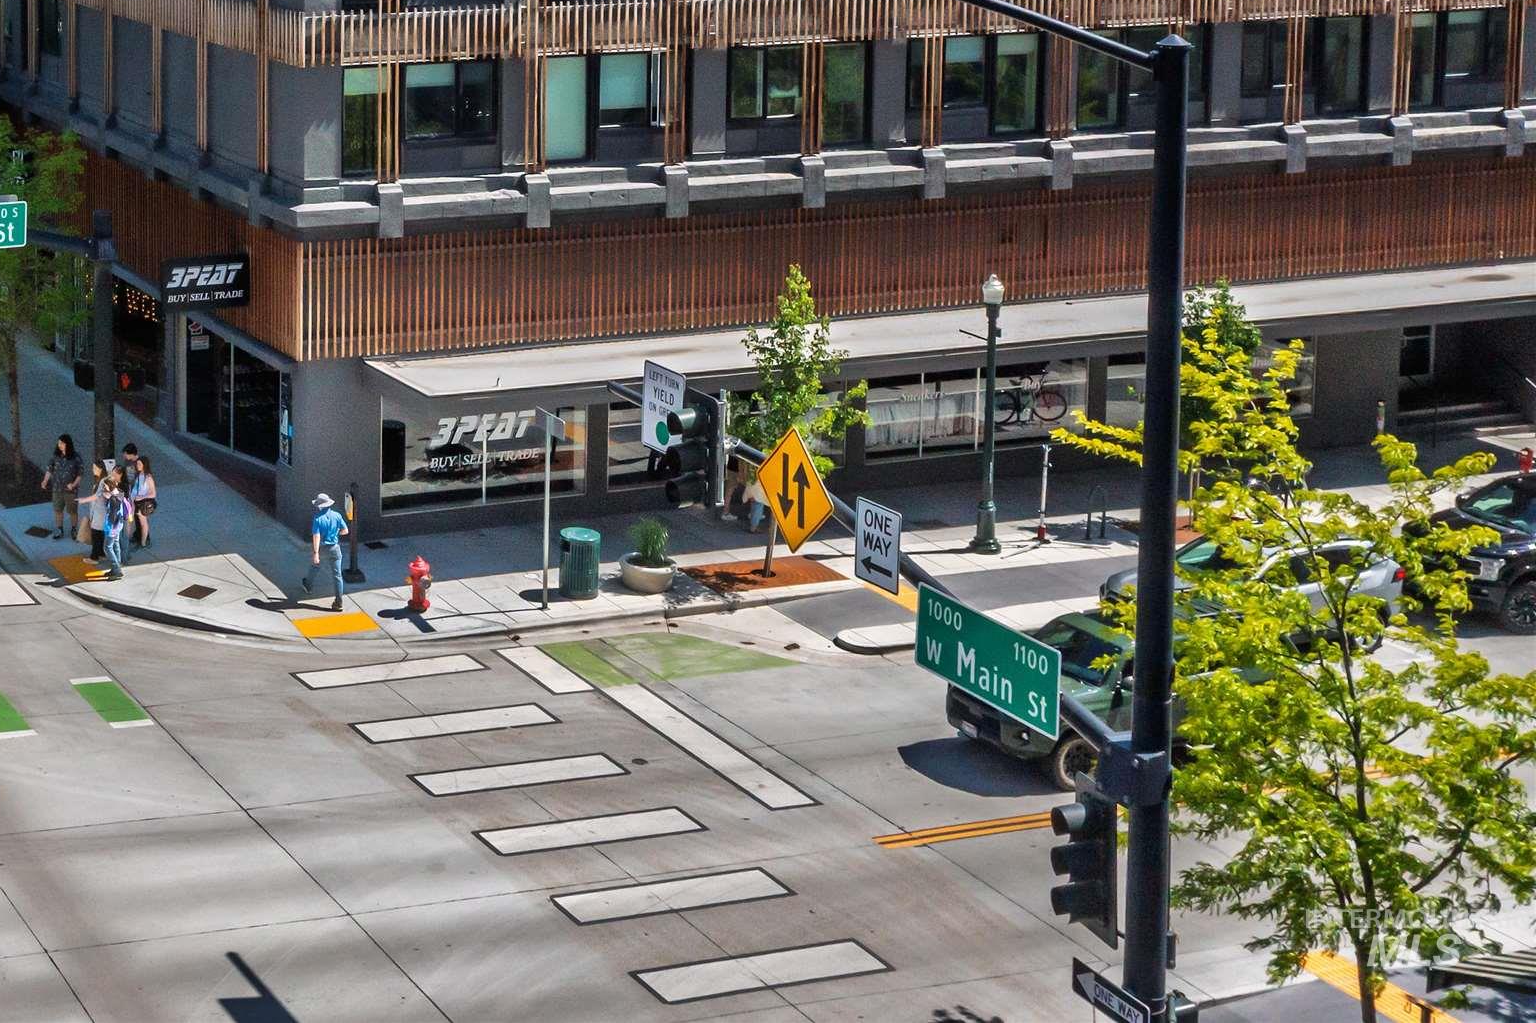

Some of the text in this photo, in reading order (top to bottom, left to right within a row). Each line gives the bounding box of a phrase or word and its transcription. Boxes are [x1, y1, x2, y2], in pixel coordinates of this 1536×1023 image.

[12, 207, 18, 218] S
[167, 290, 244, 303] BUY SELL TRADE
[649, 369, 679, 391] LEFT TURN
[654, 386, 674, 405] YIELD
[649, 402, 656, 412] ON
[429, 447, 541, 469] BUY SELL TRADE
[864, 509, 892, 536] ONE
[864, 529, 891, 557] WAY
[927, 598, 1048, 675] 1000 1100
[926, 636, 1047, 723] W Main St
[1094, 984, 1140, 1023] ONE WAY
